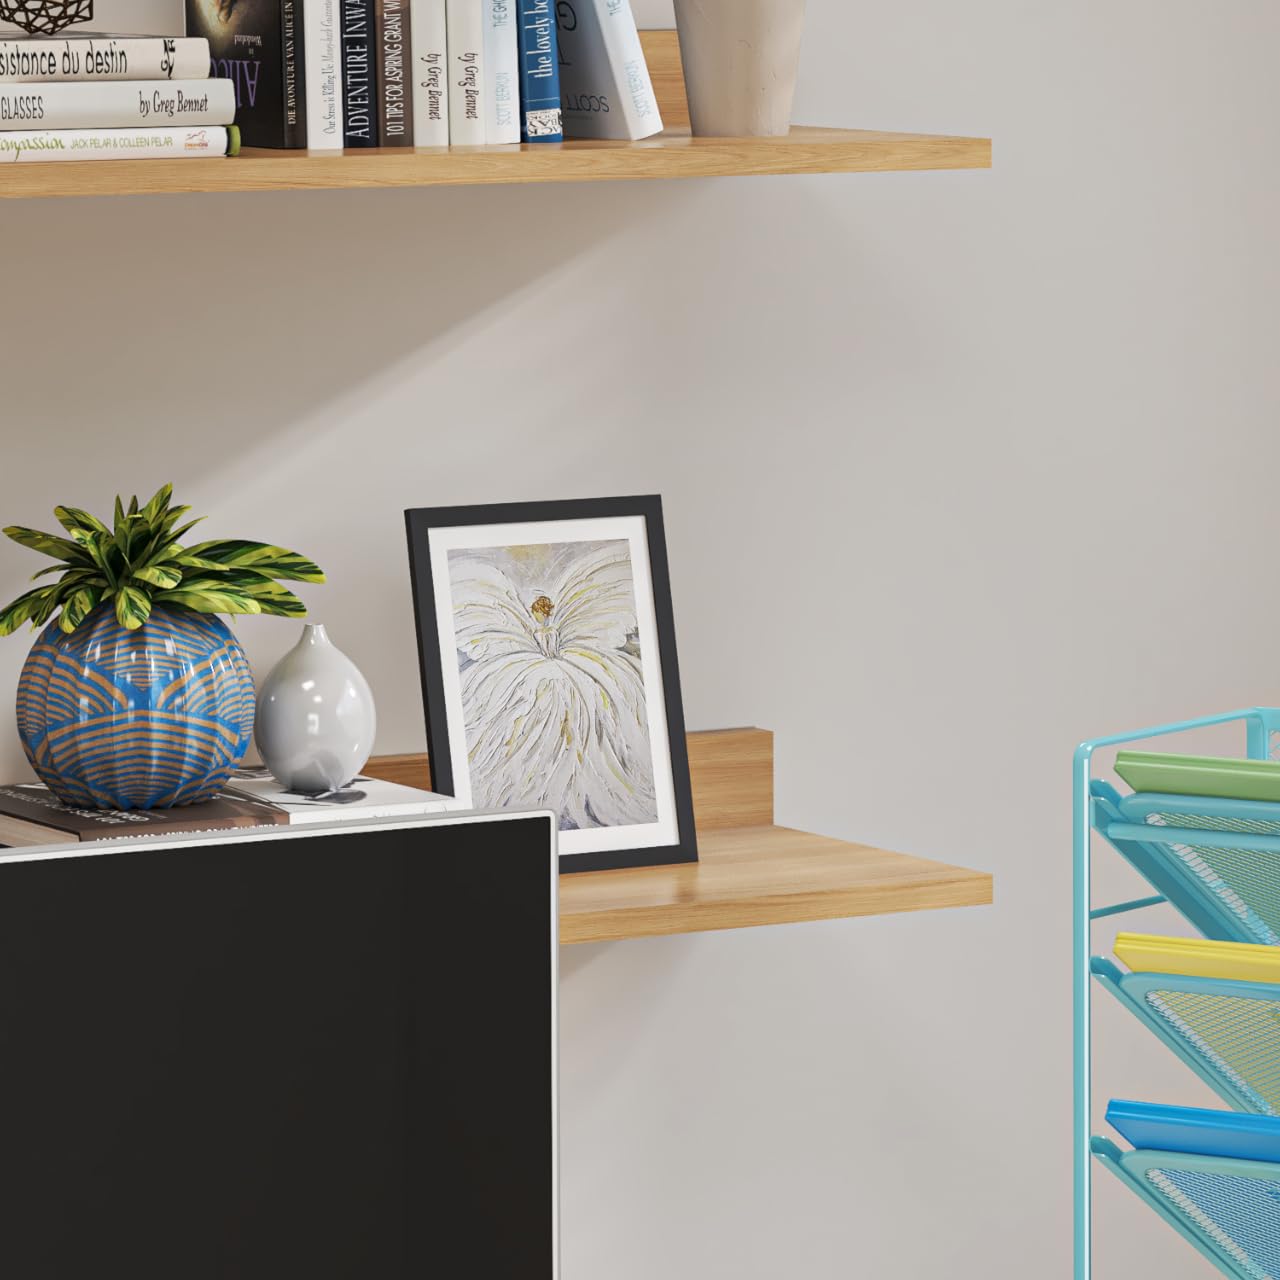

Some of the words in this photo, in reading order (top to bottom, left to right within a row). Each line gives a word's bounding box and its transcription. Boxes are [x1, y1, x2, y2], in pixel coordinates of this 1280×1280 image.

[383, 13, 402, 42] GRANT
[524, 16, 554, 54] lovely
[62, 41, 80, 74] du
[85, 40, 127, 74] destin
[286, 40, 294, 58] VAN
[421, 53, 442, 64] by
[458, 52, 479, 63] by
[384, 44, 402, 82] ASPIRING
[528, 56, 553, 78] the
[286, 61, 296, 107] AVONTURE
[421, 66, 442, 88] Greg
[458, 66, 479, 87] Greg
[345, 45, 370, 138] ADVENTURE
[385, 84, 403, 101] FOR
[1, 96, 44, 119] GLASSES
[139, 90, 150, 117] by
[153, 89, 175, 117] Greg
[177, 89, 208, 112] Bennet
[385, 103, 404, 119] TIPS
[428, 90, 442, 120] Bennet
[465, 89, 479, 120] Bennet
[566, 95, 610, 113] SCOTT
[288, 110, 296, 125] DIE
[386, 122, 404, 136] 101
